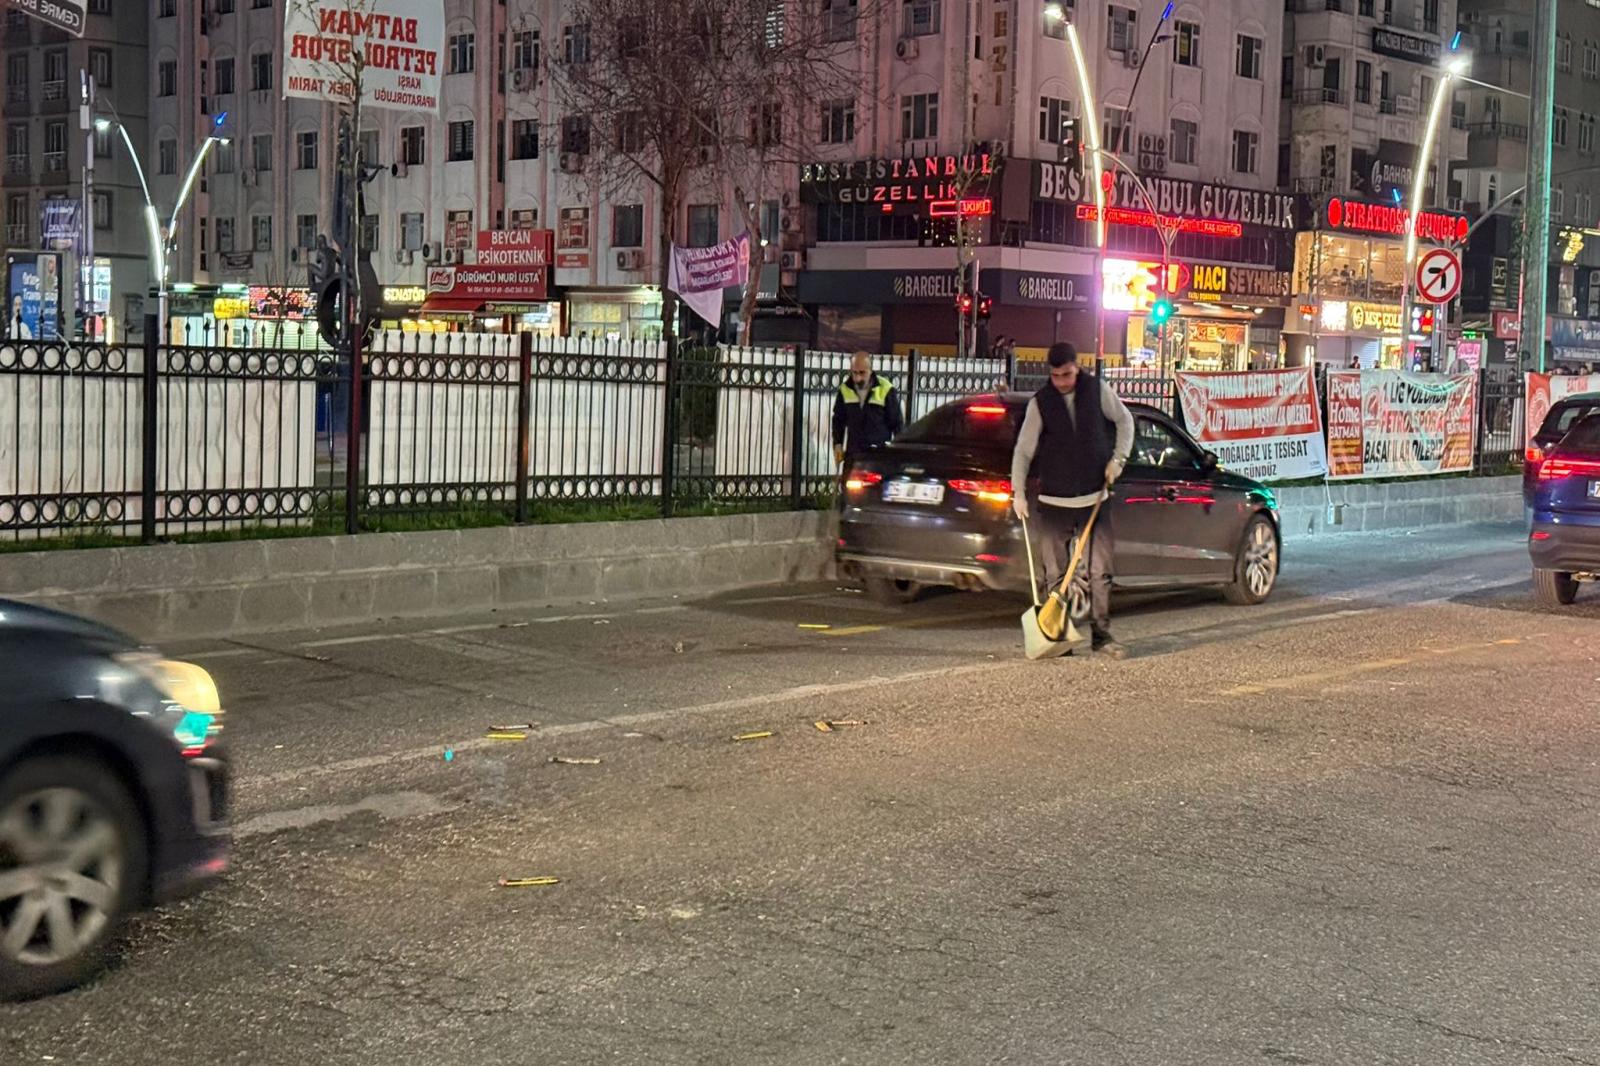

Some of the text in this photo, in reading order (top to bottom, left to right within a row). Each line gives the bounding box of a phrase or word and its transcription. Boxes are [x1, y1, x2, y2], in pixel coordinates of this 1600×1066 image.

[802, 161, 854, 182] BEST
[838, 180, 958, 203] GÜZELLİK
[1039, 161, 1095, 203] BEST
[1200, 176, 1295, 230] GÜZELLİK
[491, 230, 531, 245] BEYCAN
[478, 246, 545, 265] PSİKOTEKNİK
[456, 270, 497, 283] DÜRÜMCÜ
[497, 270, 518, 284] NURİ
[519, 272, 540, 284] USTA
[1193, 264, 1227, 292] HACI
[1028, 276, 1074, 302] BARGELLO
[1331, 377, 1361, 400] Perde
[1330, 402, 1360, 424] Home
[1329, 425, 1360, 439] BATMAN
[1220, 442, 1261, 464] DOĞALGAZ
[1261, 443, 1273, 460] VE
[1273, 437, 1308, 459] TESİSAT
[1244, 462, 1278, 479] GÜNDÜZ
